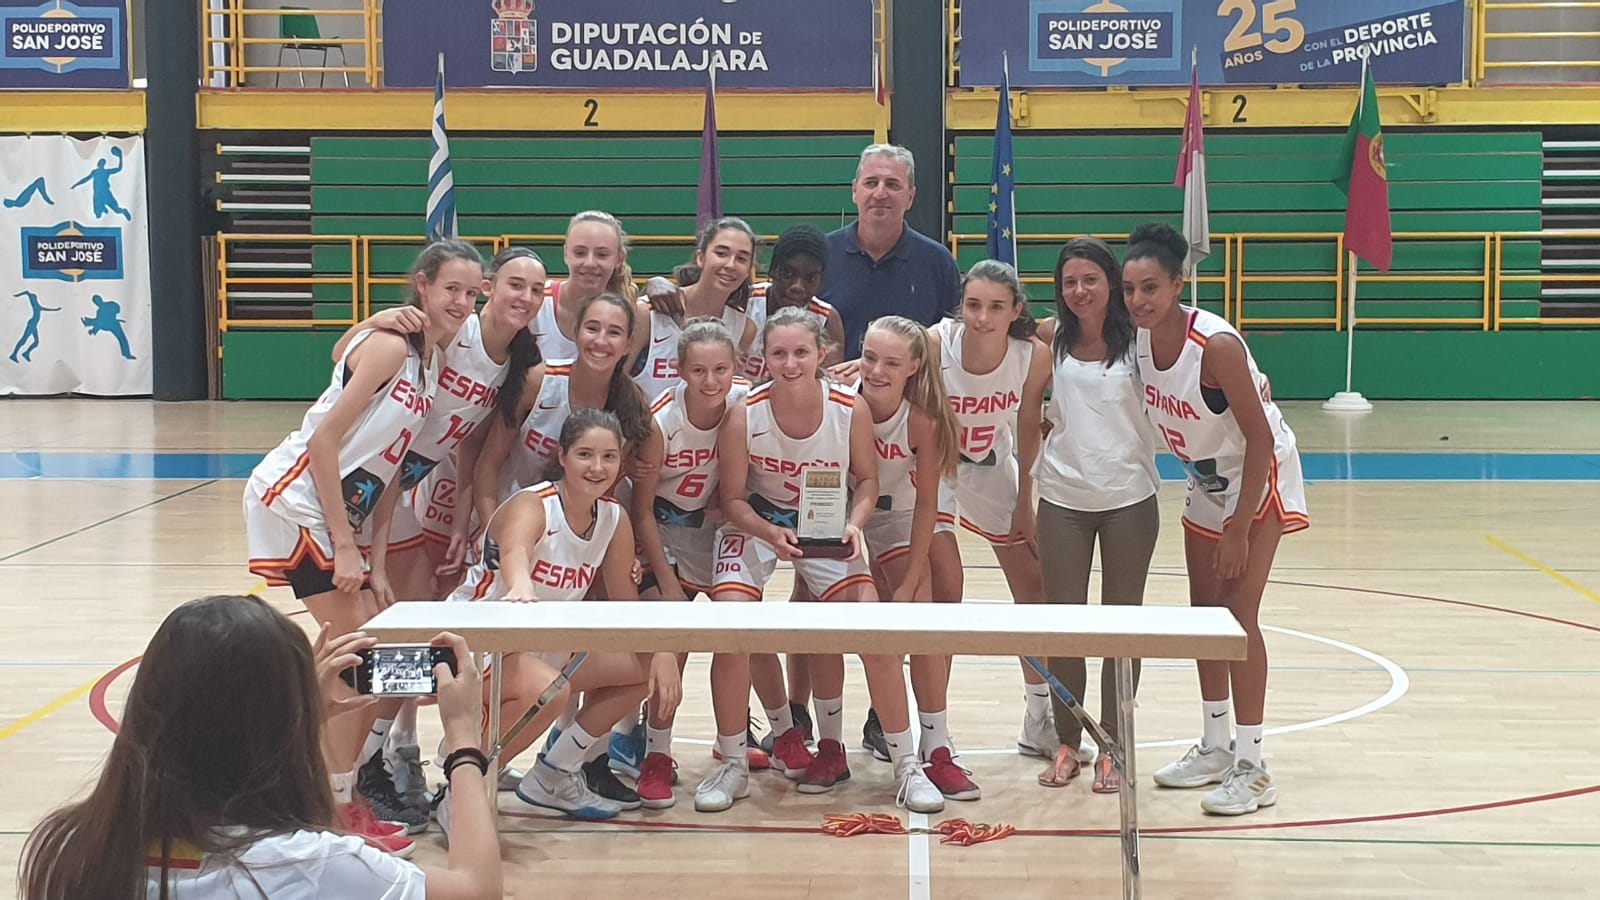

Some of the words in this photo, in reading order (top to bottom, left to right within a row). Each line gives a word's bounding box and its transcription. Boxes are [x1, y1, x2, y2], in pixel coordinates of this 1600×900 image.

[12, 23, 106, 33] POLIDEPORTIVO
[551, 17, 731, 45] DIPUTACIÓN
[739, 32, 762, 46] DE
[1048, 19, 1162, 31] POLIDEPORTIVO
[1217, 0, 1305, 54] 25
[1303, 40, 1328, 52] CON
[1330, 38, 1343, 47] EL
[1344, 12, 1433, 44] DEPORTE
[12, 35, 50, 50] SAN
[54, 32, 103, 50] JOSÉ
[1048, 33, 1093, 50] SAN
[1099, 30, 1158, 50] JOSÉ
[1300, 62, 1314, 72] DE
[1317, 58, 1331, 69] LA
[1332, 31, 1438, 65] PROVINCIA
[550, 48, 769, 71] GUADALAJARA
[1224, 51, 1264, 69] AÑOS
[583, 99, 599, 127] 2
[1232, 95, 1248, 124] 2
[37, 241, 104, 250] POLIDEPORTIVO
[38, 251, 67, 262] SAN
[70, 249, 103, 263] JOSÉ
[947, 390, 1020, 415] SPAÑA
[436, 414, 475, 450] 14
[676, 474, 709, 498] 6
[530, 559, 597, 589] ESPAÑ
